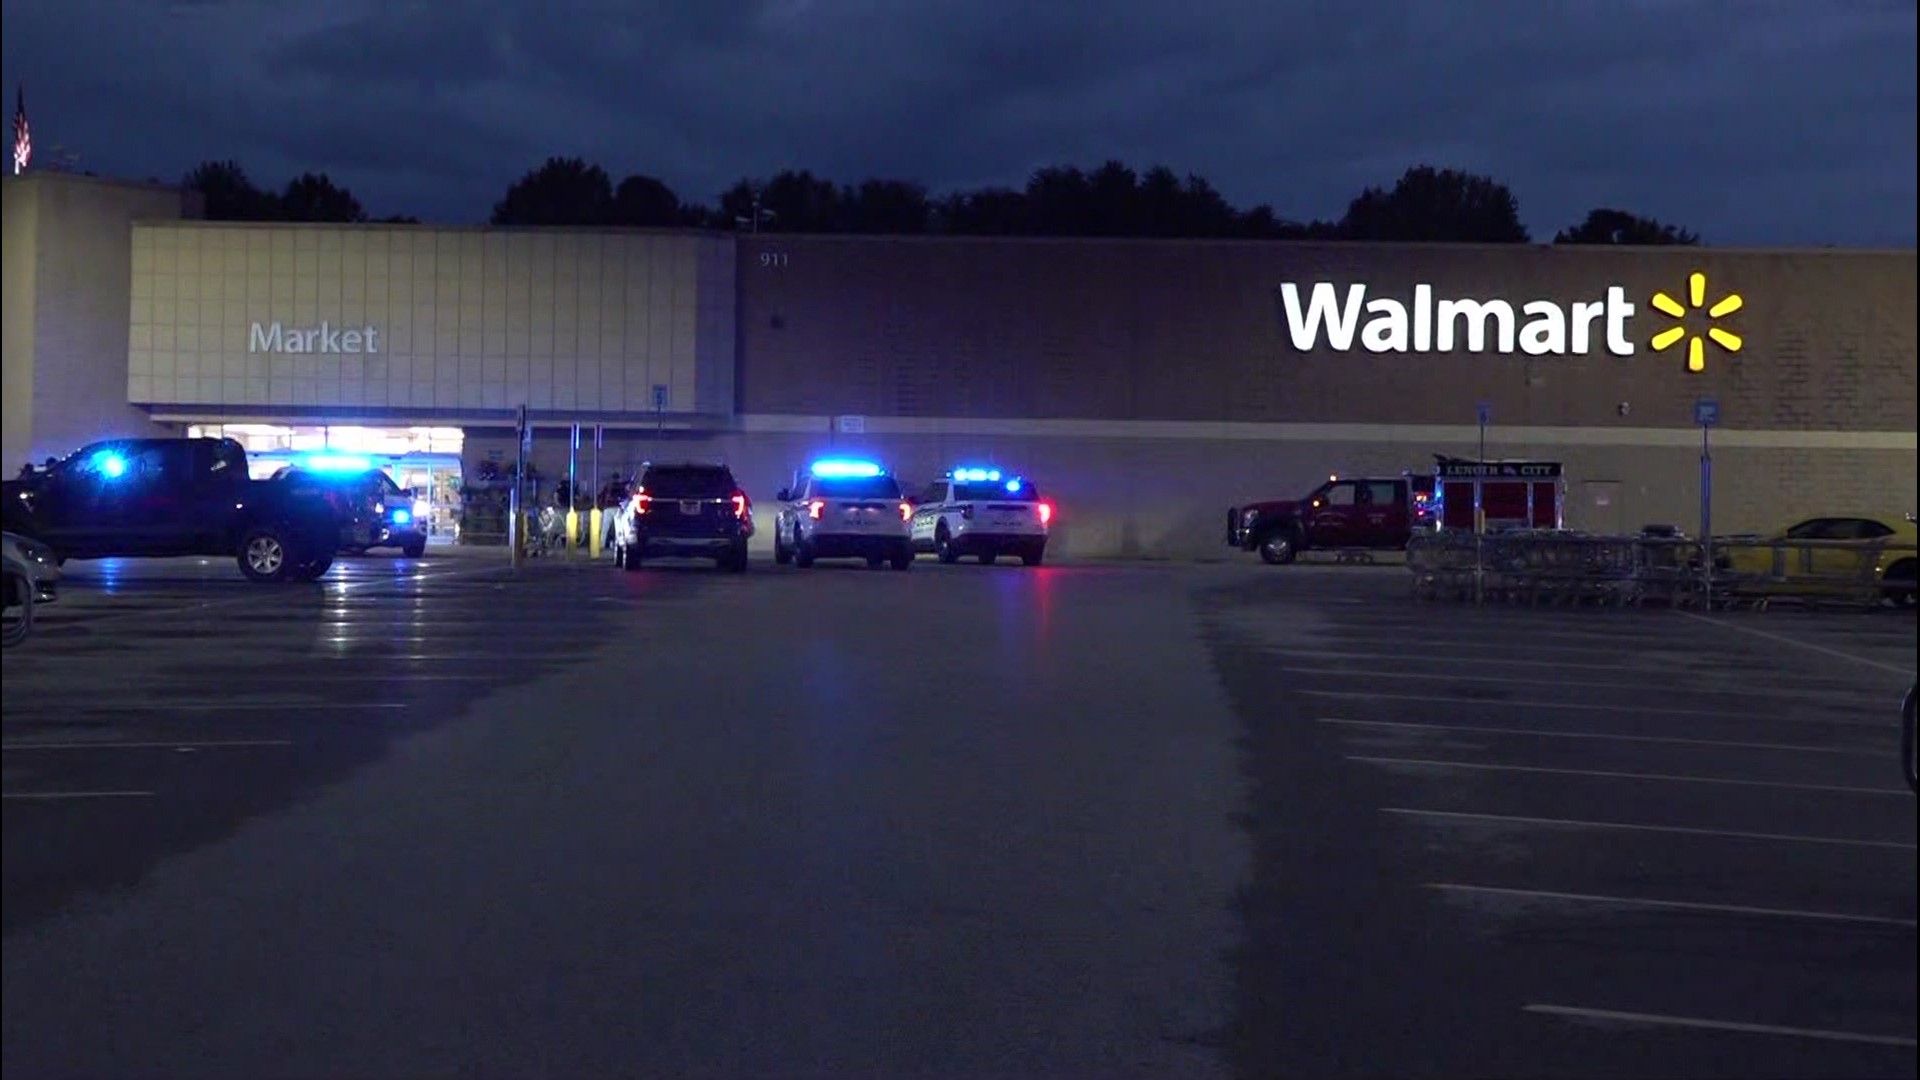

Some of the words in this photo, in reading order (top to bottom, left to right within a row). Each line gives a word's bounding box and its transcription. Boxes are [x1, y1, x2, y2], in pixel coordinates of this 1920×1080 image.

[760, 252, 789, 267] 911
[1280, 282, 1636, 355] Walmart
[249, 321, 378, 354] Market
[1446, 465, 1499, 476] LENOIR
[1520, 465, 1553, 476] CITY
